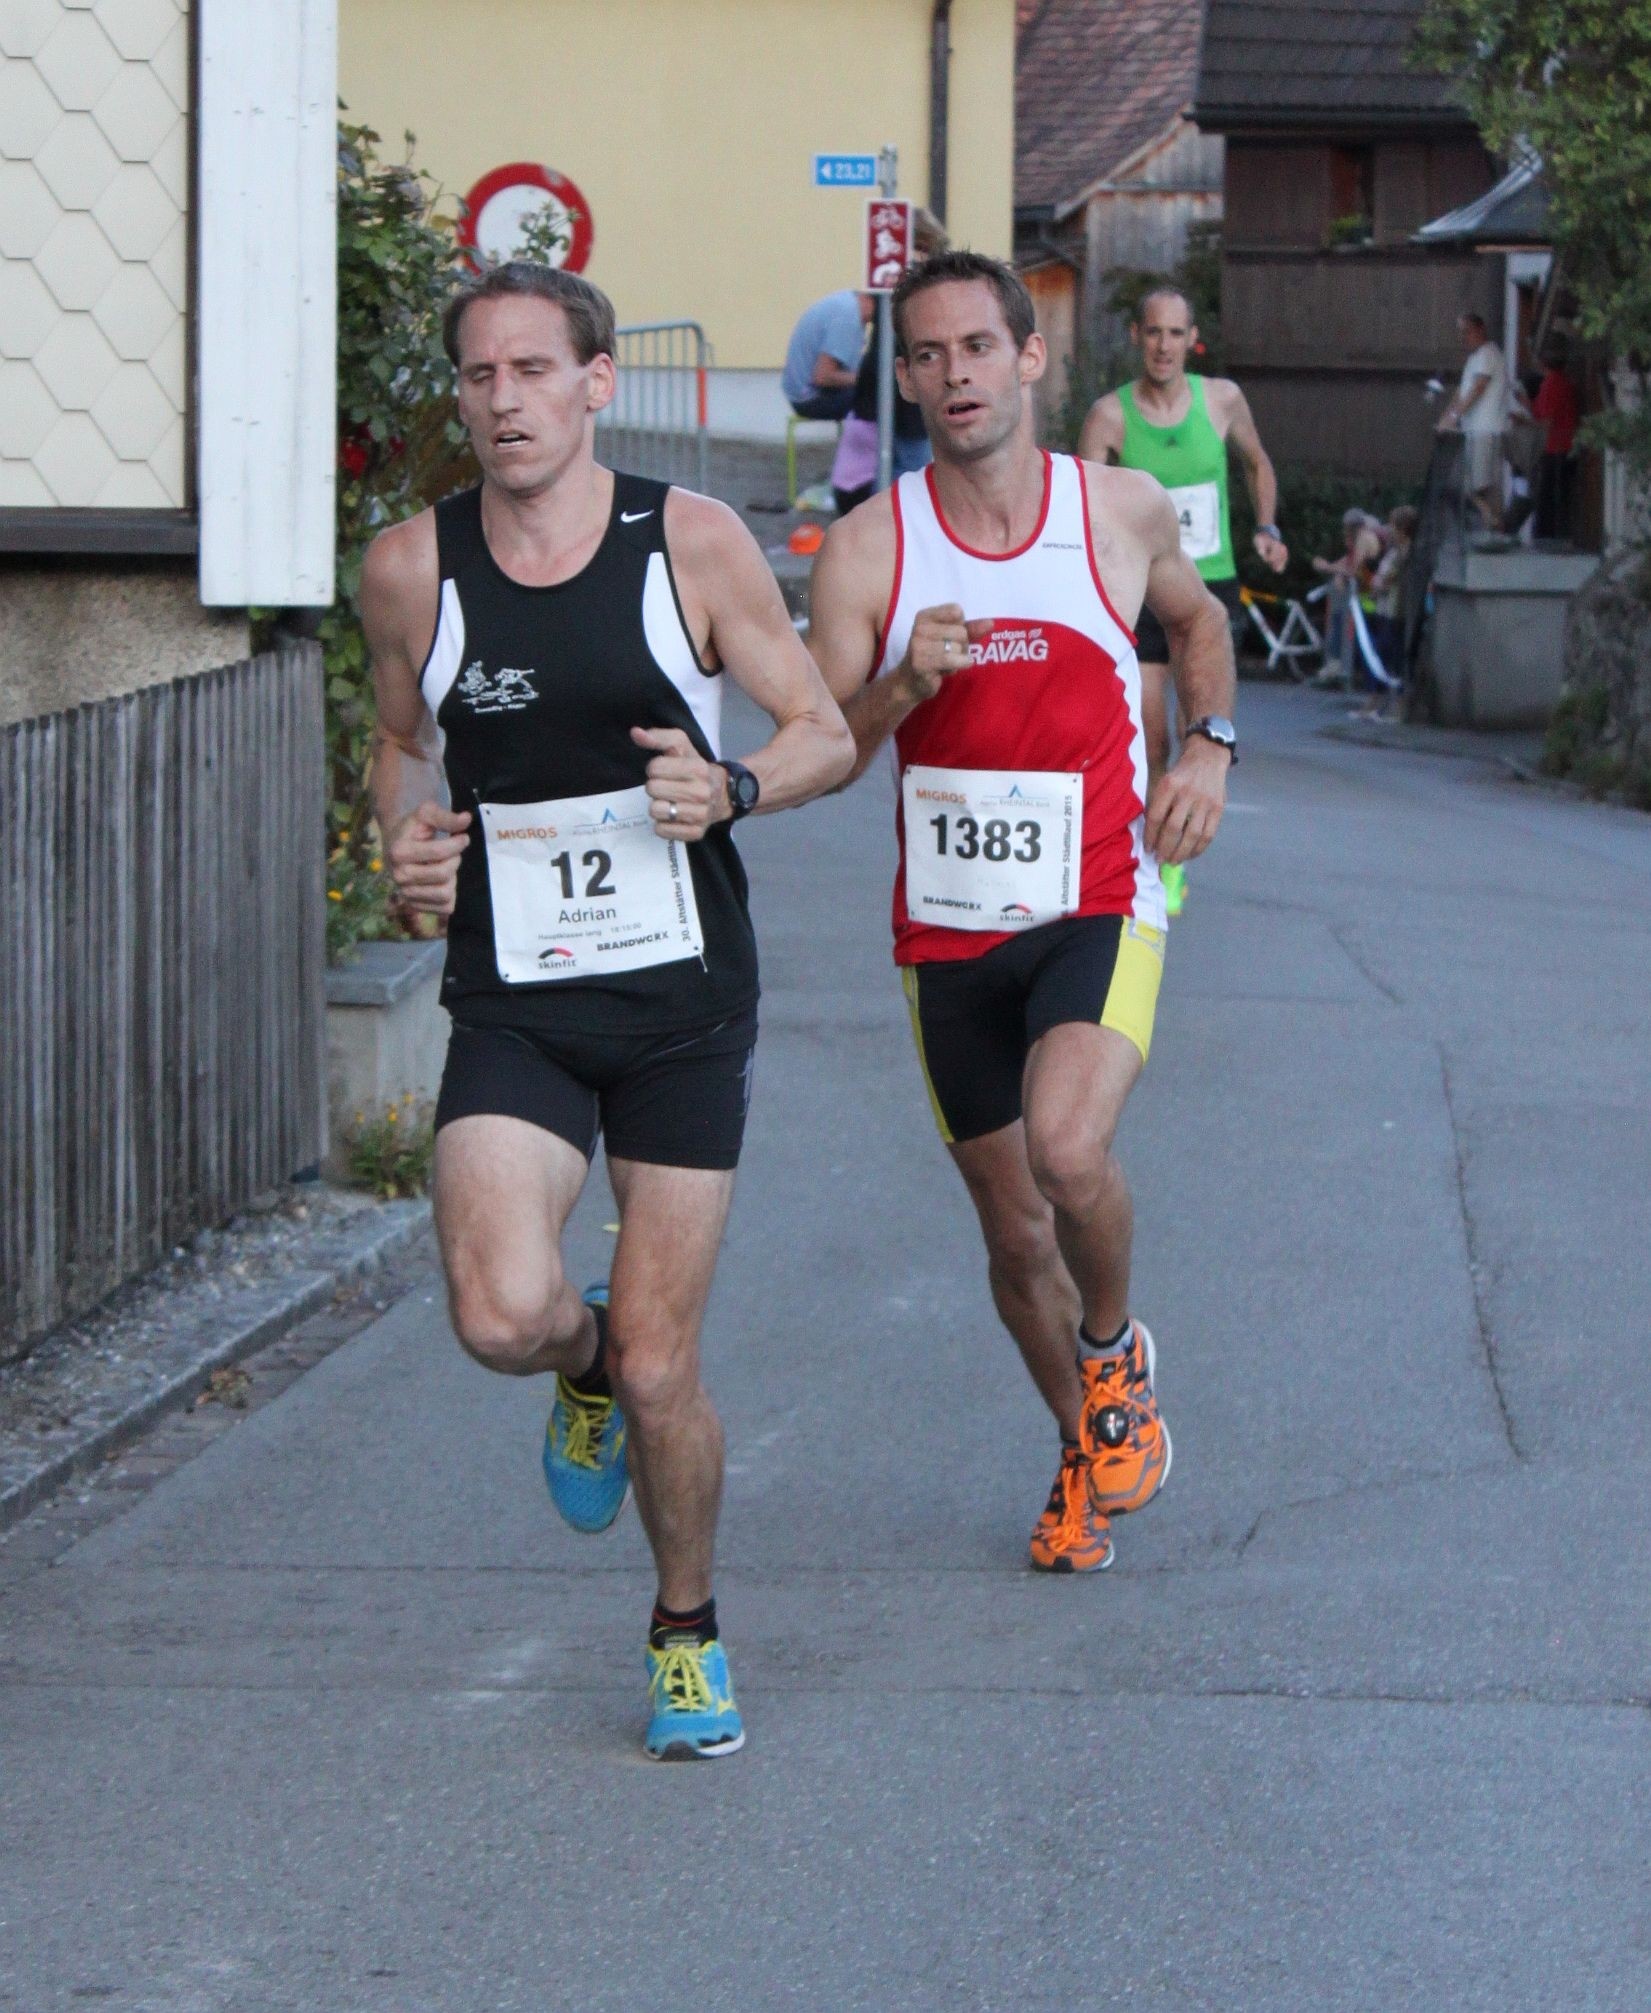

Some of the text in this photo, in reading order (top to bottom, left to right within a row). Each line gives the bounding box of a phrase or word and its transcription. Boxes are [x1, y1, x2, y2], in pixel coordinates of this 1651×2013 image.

[991, 629, 1026, 641] erdgas
[968, 638, 1049, 665] RAVAG
[916, 789, 967, 804] MIGROS
[1064, 795, 1073, 816] 2015
[497, 827, 558, 841] MIGROS
[930, 813, 1042, 863] 1383
[550, 849, 617, 899] 12
[558, 907, 617, 924] Adrian
[681, 927, 691, 942] 30.
[538, 958, 577, 970] skinfit
